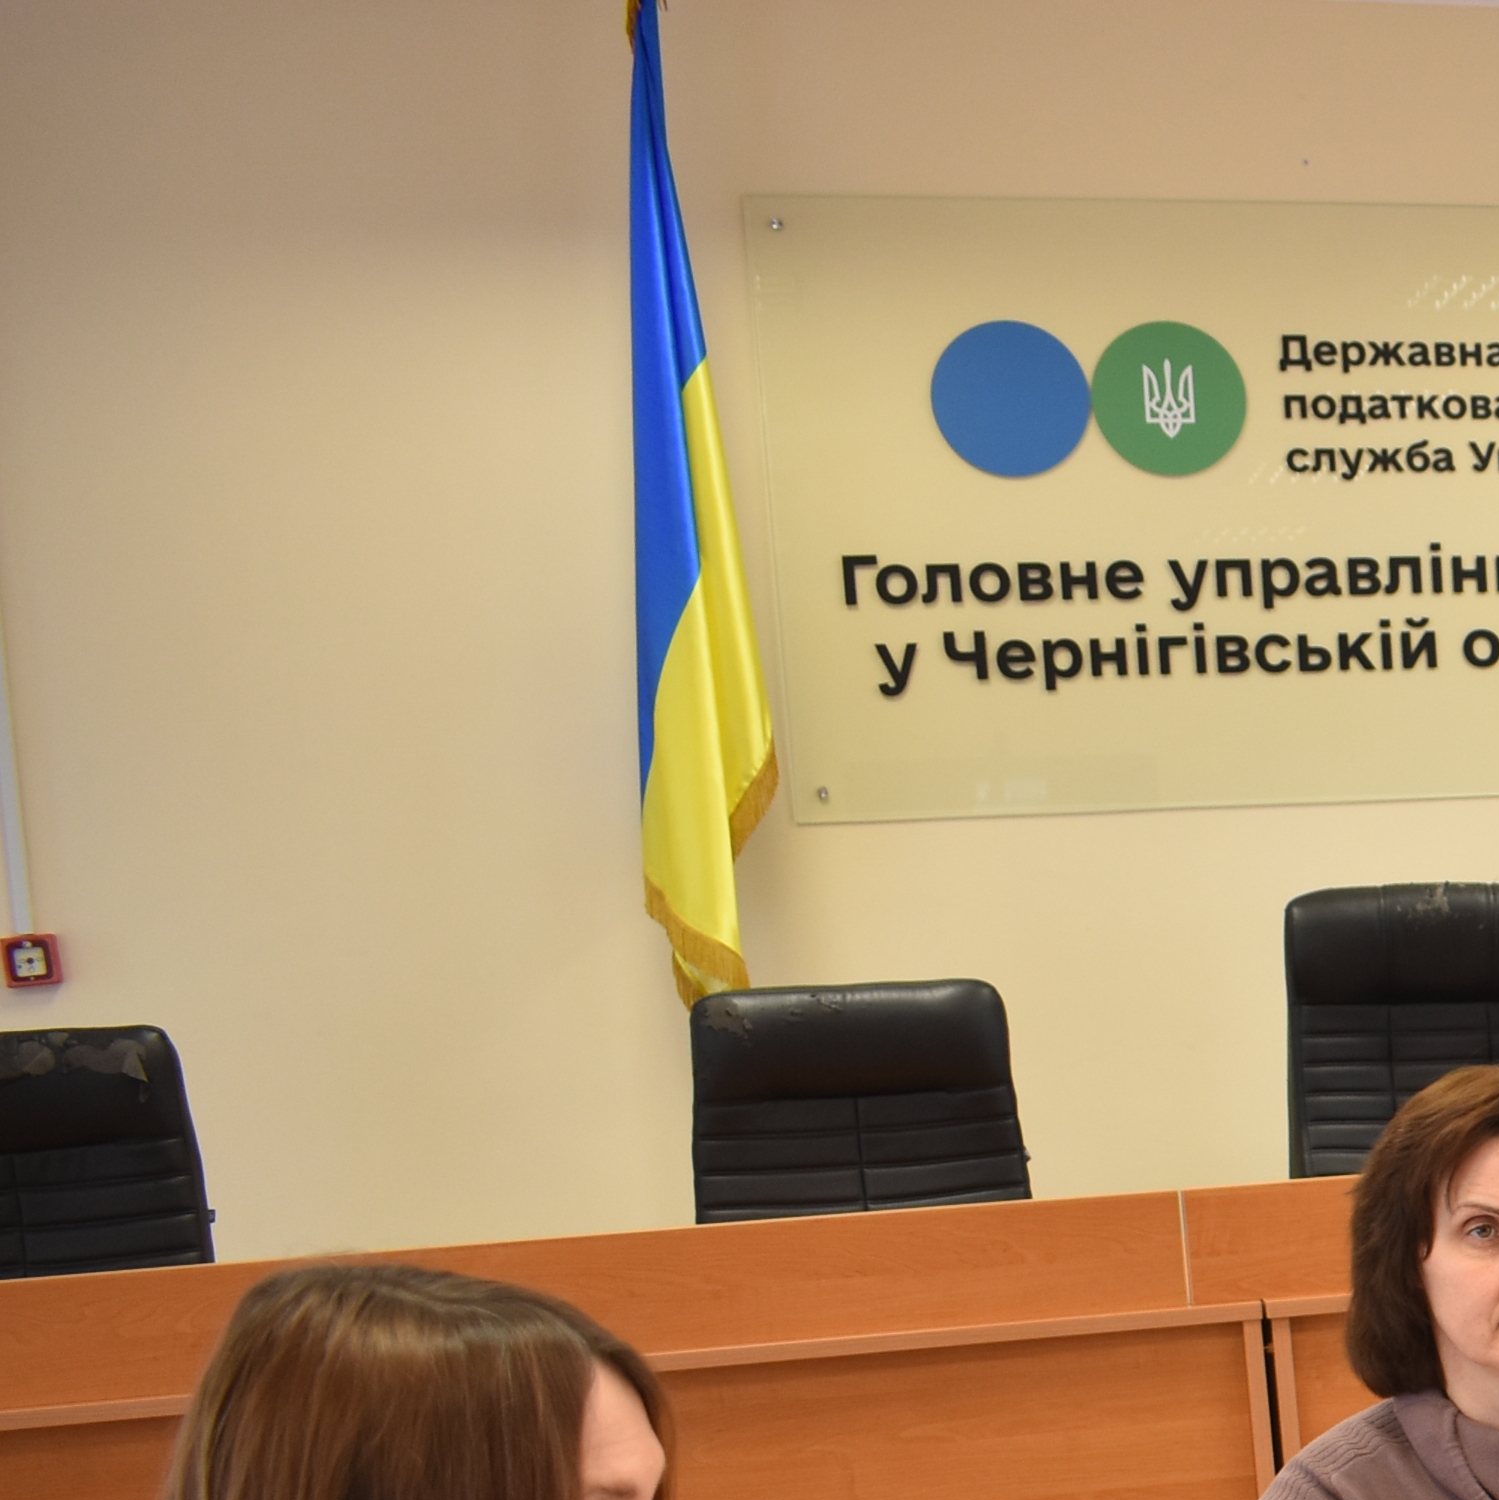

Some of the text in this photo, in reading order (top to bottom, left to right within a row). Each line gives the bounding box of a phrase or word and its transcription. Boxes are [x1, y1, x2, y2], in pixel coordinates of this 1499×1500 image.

[1285, 439, 1456, 481] служба
[840, 553, 1145, 607] Головне
[874, 641, 918, 698] у
[942, 616, 1439, 692] Чернігівській
